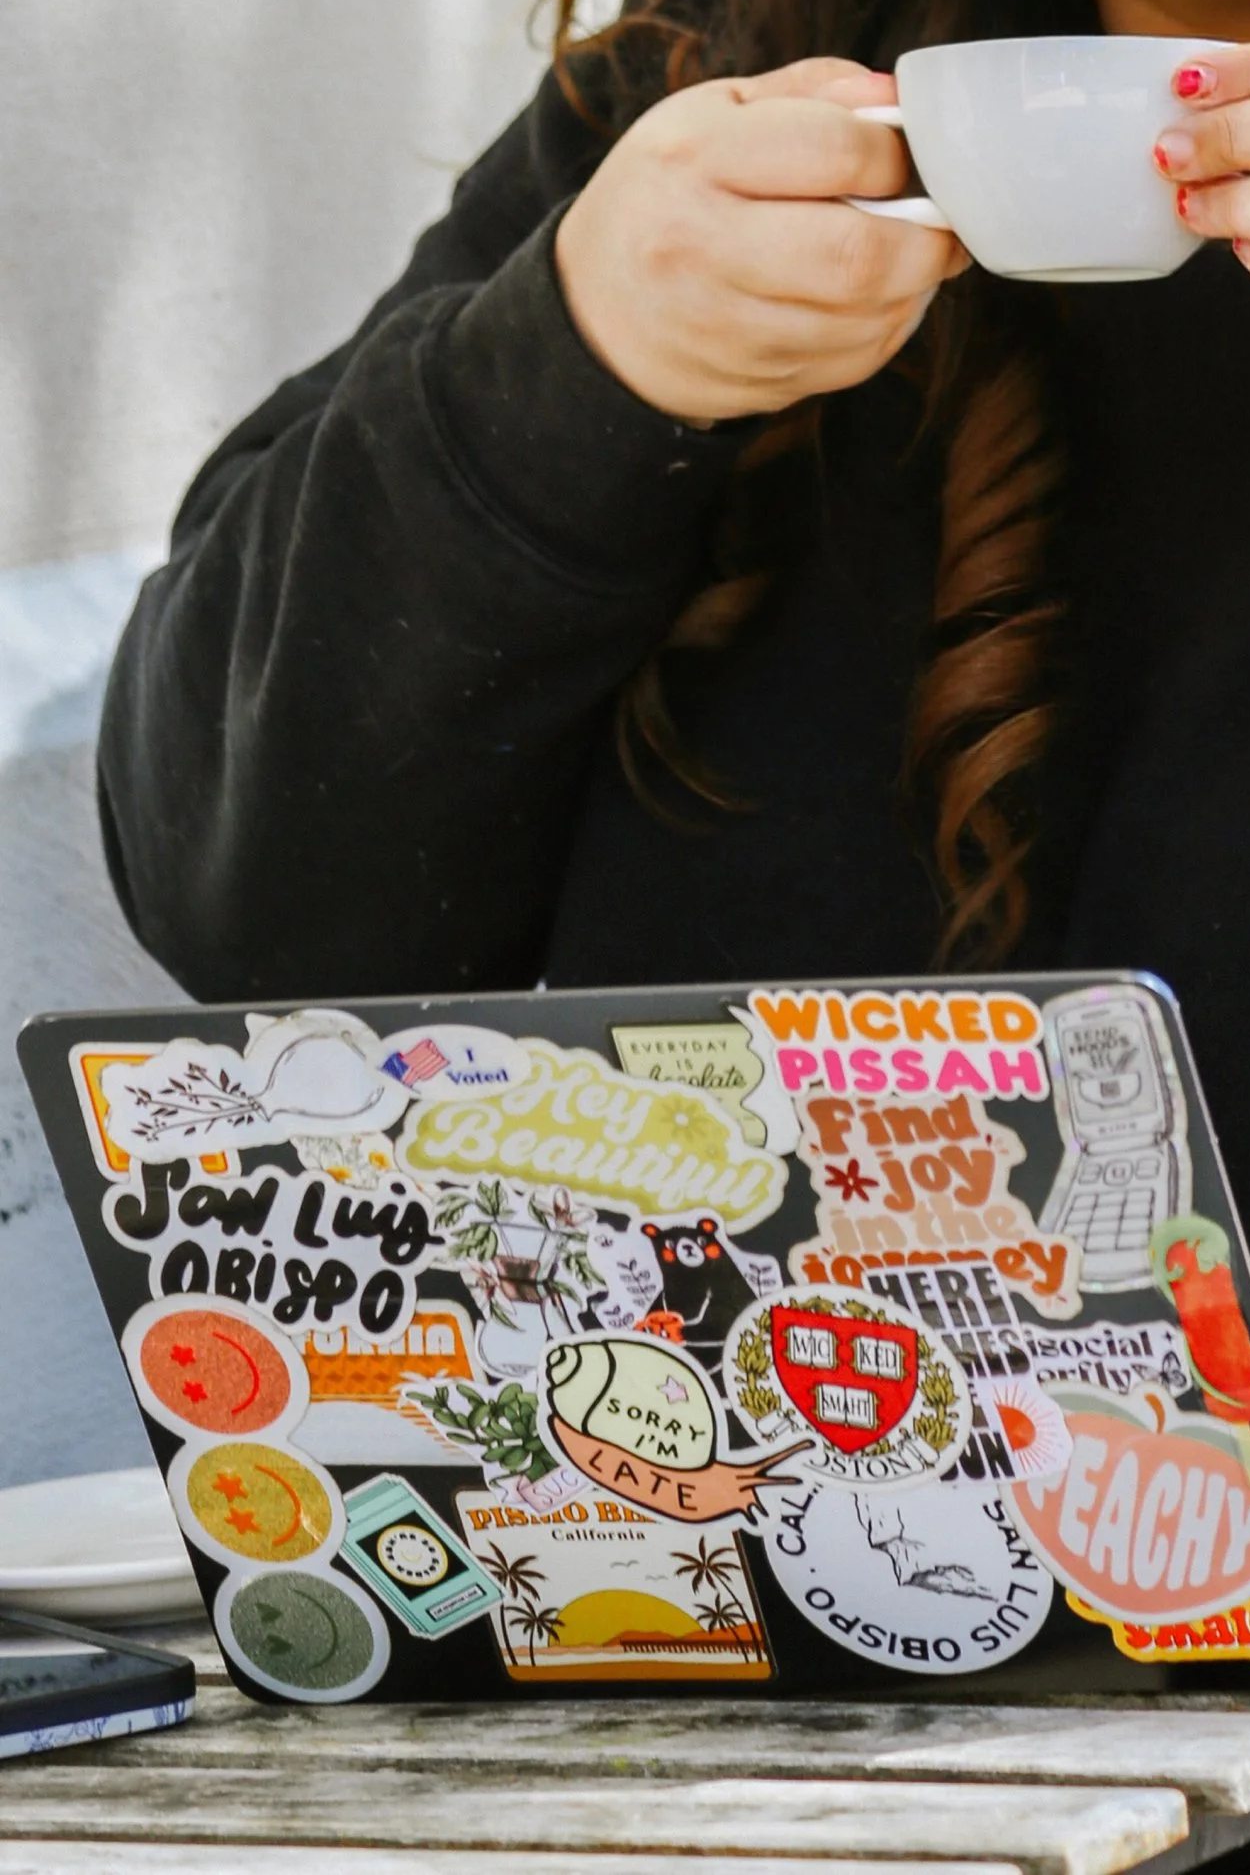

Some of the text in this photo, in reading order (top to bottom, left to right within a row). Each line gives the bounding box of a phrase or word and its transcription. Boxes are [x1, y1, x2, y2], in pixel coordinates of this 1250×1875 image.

[754, 996, 1038, 1043] WICKED
[466, 1046, 475, 1063] I
[630, 1040, 727, 1054] EVERYDAY
[675, 1058, 693, 1071] IS
[778, 1049, 1042, 1093] PISSAH
[446, 1067, 508, 1087] Voted
[502, 1059, 652, 1142] Hey
[807, 1098, 978, 1155] Find
[424, 1101, 764, 1206] Beautiful
[882, 1143, 996, 1212] joy
[294, 1180, 446, 1265] Luis
[830, 1192, 1025, 1252] in the
[793, 1330, 897, 1370] WIC KED
[606, 1397, 706, 1445] SORRY
[823, 1391, 869, 1420] SMAHT
[634, 1433, 679, 1461] I'M
[588, 1449, 699, 1512] LATE
[551, 1528, 646, 1542] California
[982, 1499, 1039, 1571] SAN
[804, 1587, 961, 1662] OBISPO
[970, 1582, 1038, 1652] LUIS
